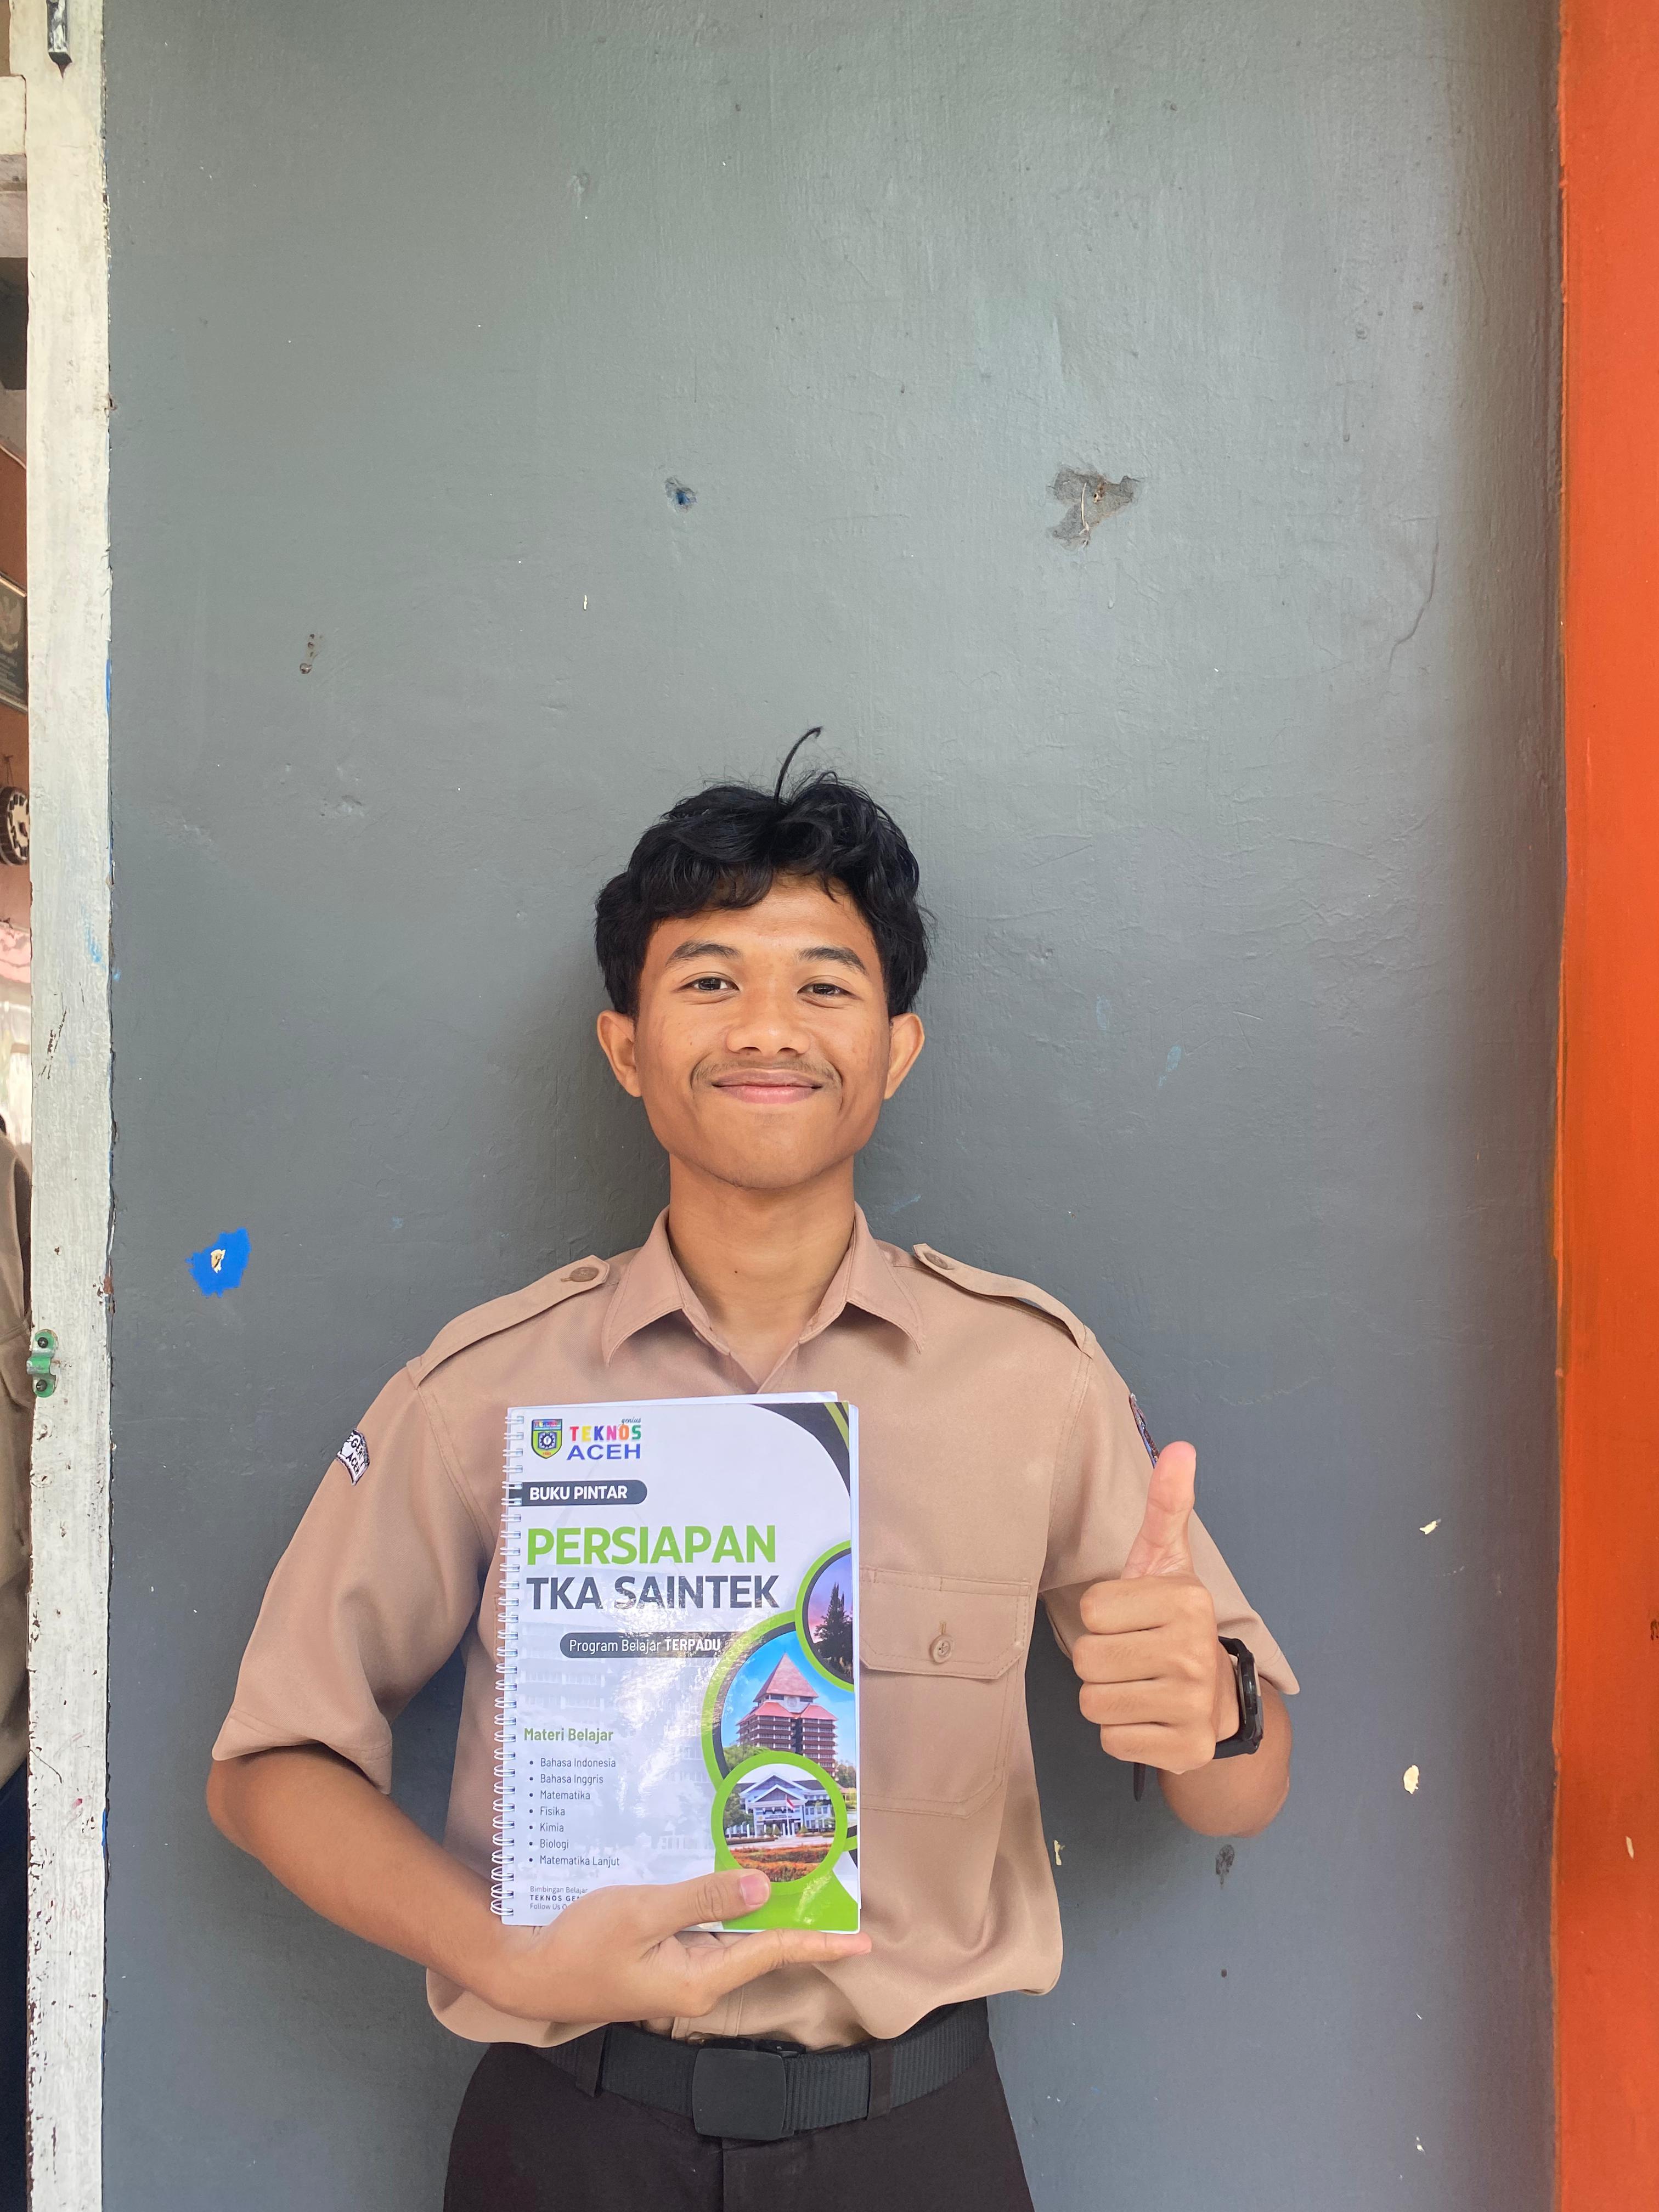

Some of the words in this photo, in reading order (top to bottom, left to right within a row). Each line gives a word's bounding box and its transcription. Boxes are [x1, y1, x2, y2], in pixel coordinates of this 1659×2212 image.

[621, 1417, 641, 1425] genius
[569, 1425, 641, 1442] TEKNOS
[566, 1443, 641, 1460] ACEH
[346, 1453, 360, 1476] ACEH
[529, 1486, 570, 1500] BUKU
[574, 1485, 628, 1499] PINTAR
[527, 1525, 776, 1565] PERSIAPAN
[526, 1576, 603, 1610] TKA
[614, 1575, 780, 1609] SAINTEK
[569, 1639, 618, 1655] Program
[622, 1639, 661, 1655] Belajar
[664, 1639, 720, 1651] TERPADU
[524, 1728, 564, 1741] Materi
[568, 1728, 614, 1745] Belajar
[540, 1758, 572, 1767] Bahasa
[574, 1758, 616, 1768] Indonesia
[540, 1774, 572, 1783] Bahasa
[574, 1774, 604, 1786] Inggris
[540, 1790, 590, 1800] Matematika
[540, 1806, 565, 1816] Fisika
[540, 1822, 564, 1832] Kimia
[540, 1839, 569, 1851] Biologi
[540, 1855, 590, 1865] Matematika
[592, 1856, 620, 1869] Lanjut
[530, 1886, 564, 1894] Bimbingan
